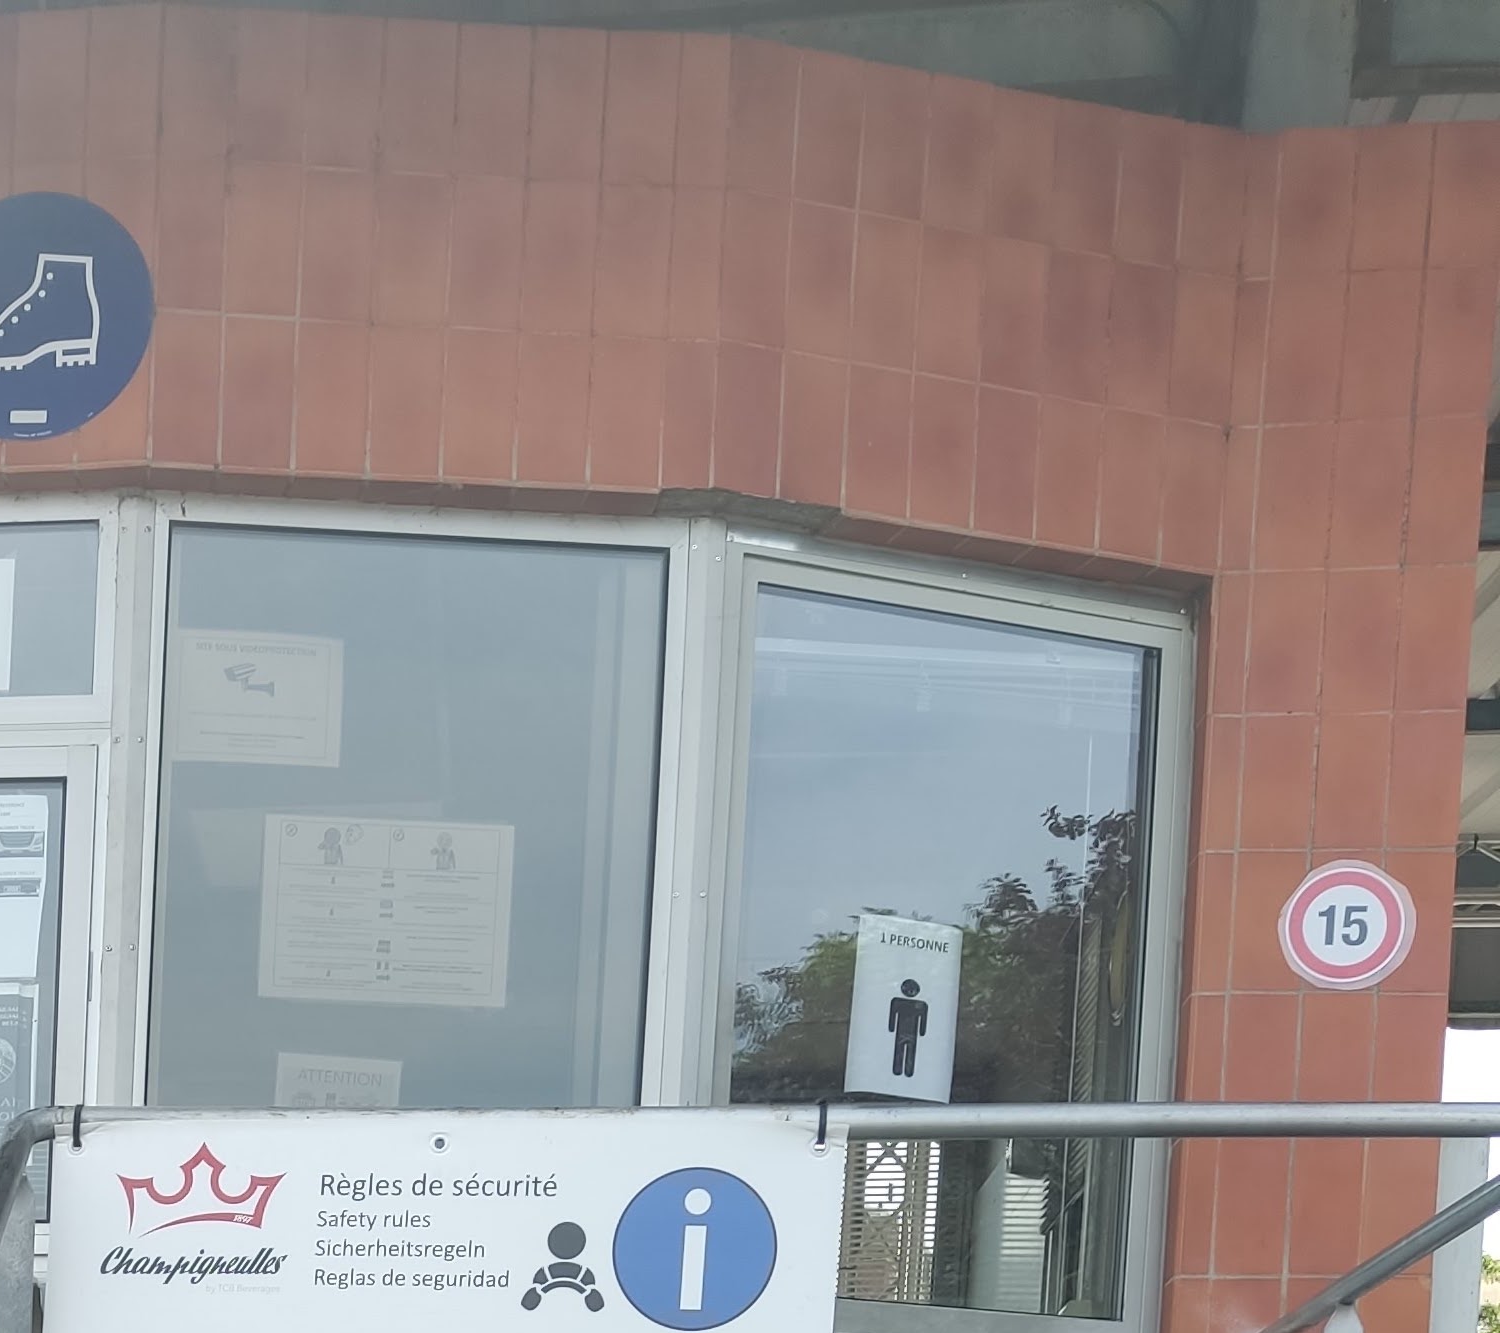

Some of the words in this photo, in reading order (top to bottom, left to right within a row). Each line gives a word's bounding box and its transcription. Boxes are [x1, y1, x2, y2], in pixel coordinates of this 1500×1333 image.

[1318, 904, 1368, 946] 15
[880, 933, 886, 943] 1
[890, 934, 949, 953] PERSONNE
[320, 1173, 403, 1201] Règles
[412, 1173, 443, 1196] de
[452, 1173, 558, 1197] sécurité
[317, 1210, 377, 1231] Safety
[383, 1210, 431, 1228] rules
[315, 1239, 485, 1262] Sicherheitsregeln
[100, 1246, 289, 1285] Champigneulles
[314, 1268, 376, 1290] Reglas
[382, 1268, 406, 1287] de
[412, 1270, 510, 1291] seguridad
